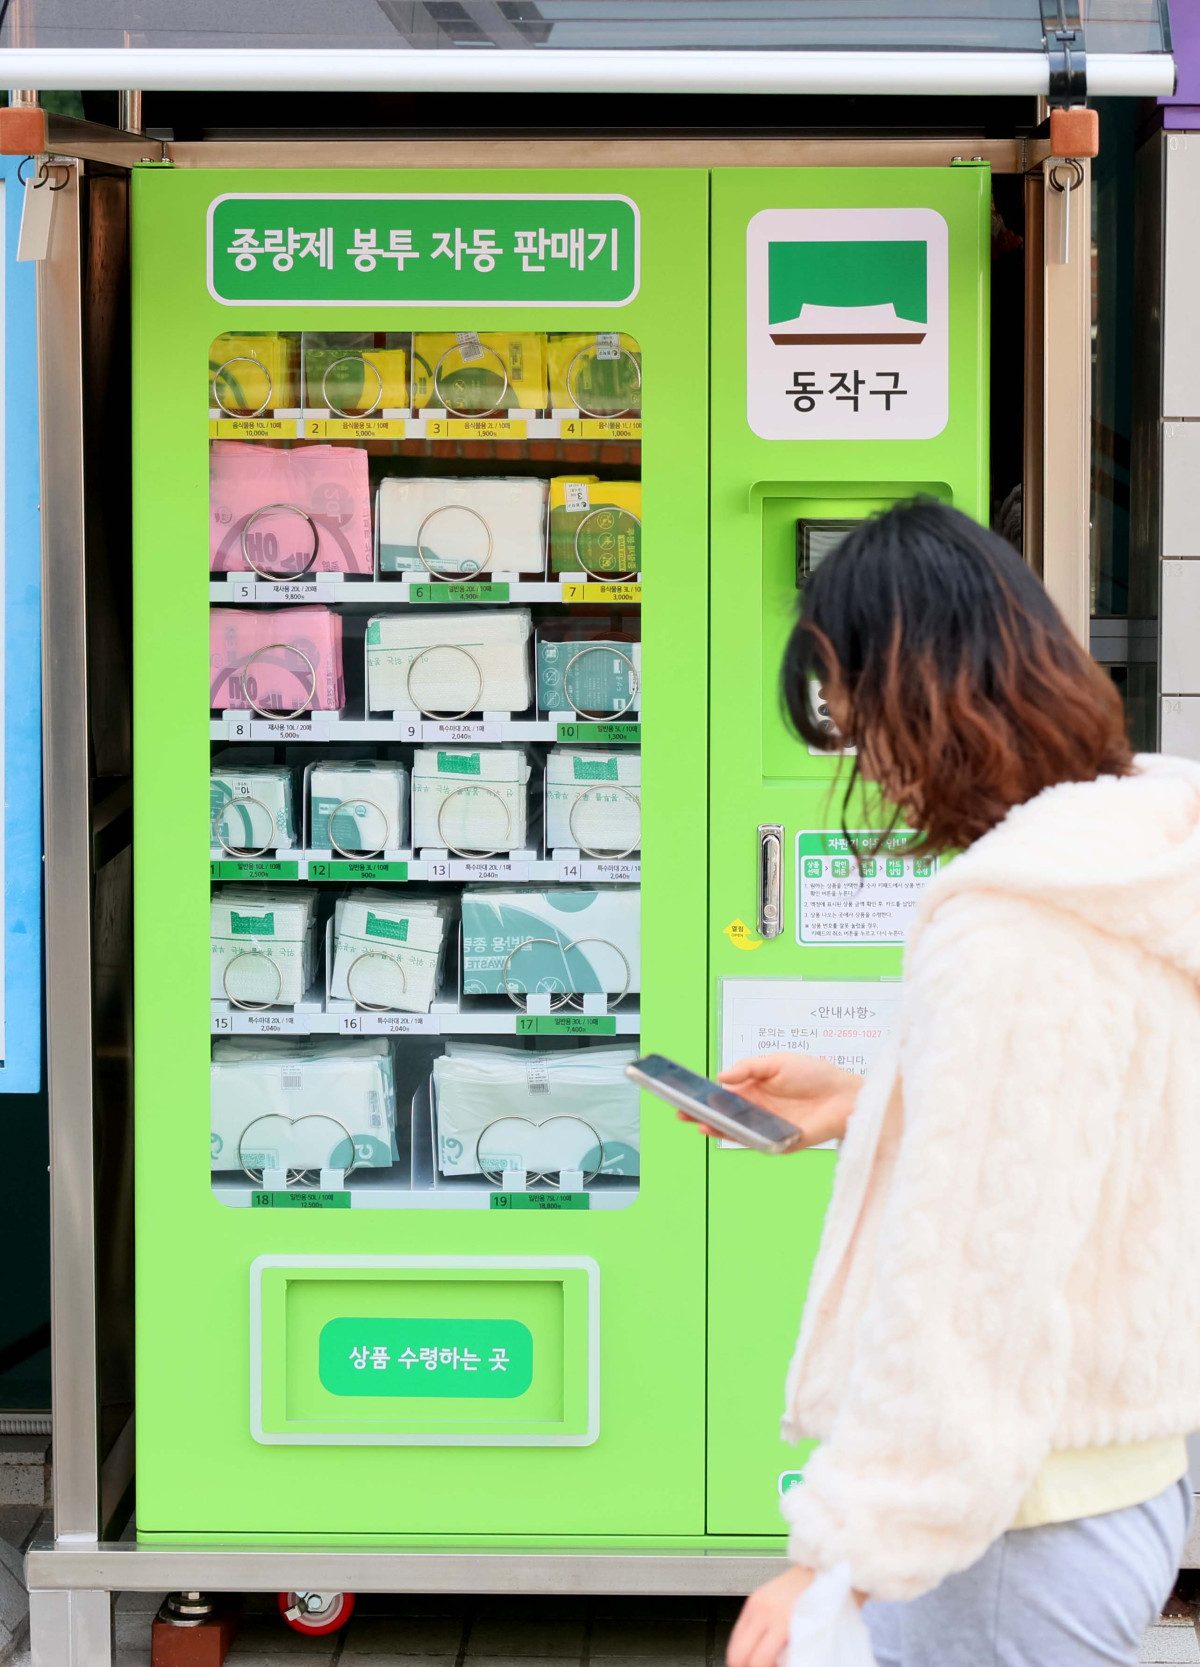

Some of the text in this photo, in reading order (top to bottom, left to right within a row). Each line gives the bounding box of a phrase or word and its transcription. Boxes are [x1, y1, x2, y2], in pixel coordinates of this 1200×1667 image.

[226, 227, 618, 273] 종량제 봉투 자동 판매기
[785, 369, 907, 412] 동작구
[312, 424, 318, 434] 2
[434, 424, 440, 433] 3
[568, 424, 574, 433] 4
[242, 587, 248, 596] 5
[416, 588, 423, 597] 6
[569, 587, 576, 597] 7
[237, 725, 243, 734] 8
[408, 727, 415, 736] 9
[561, 727, 574, 736] 10
[211, 865, 214, 874] 1
[313, 866, 325, 875] 12
[433, 866, 445, 875] 13
[564, 867, 577, 876] 14
[810, 1006, 876, 1019] <안내사항>
[215, 1019, 227, 1028] 15
[344, 1019, 357, 1028] 16
[520, 1020, 533, 1029] 17
[758, 1027, 882, 1039] 문의는 반드시 02-2659-1027
[256, 1195, 269, 1205] 18
[494, 1197, 507, 1206] 19
[349, 1346, 510, 1371] 상품 수령하는 곳
